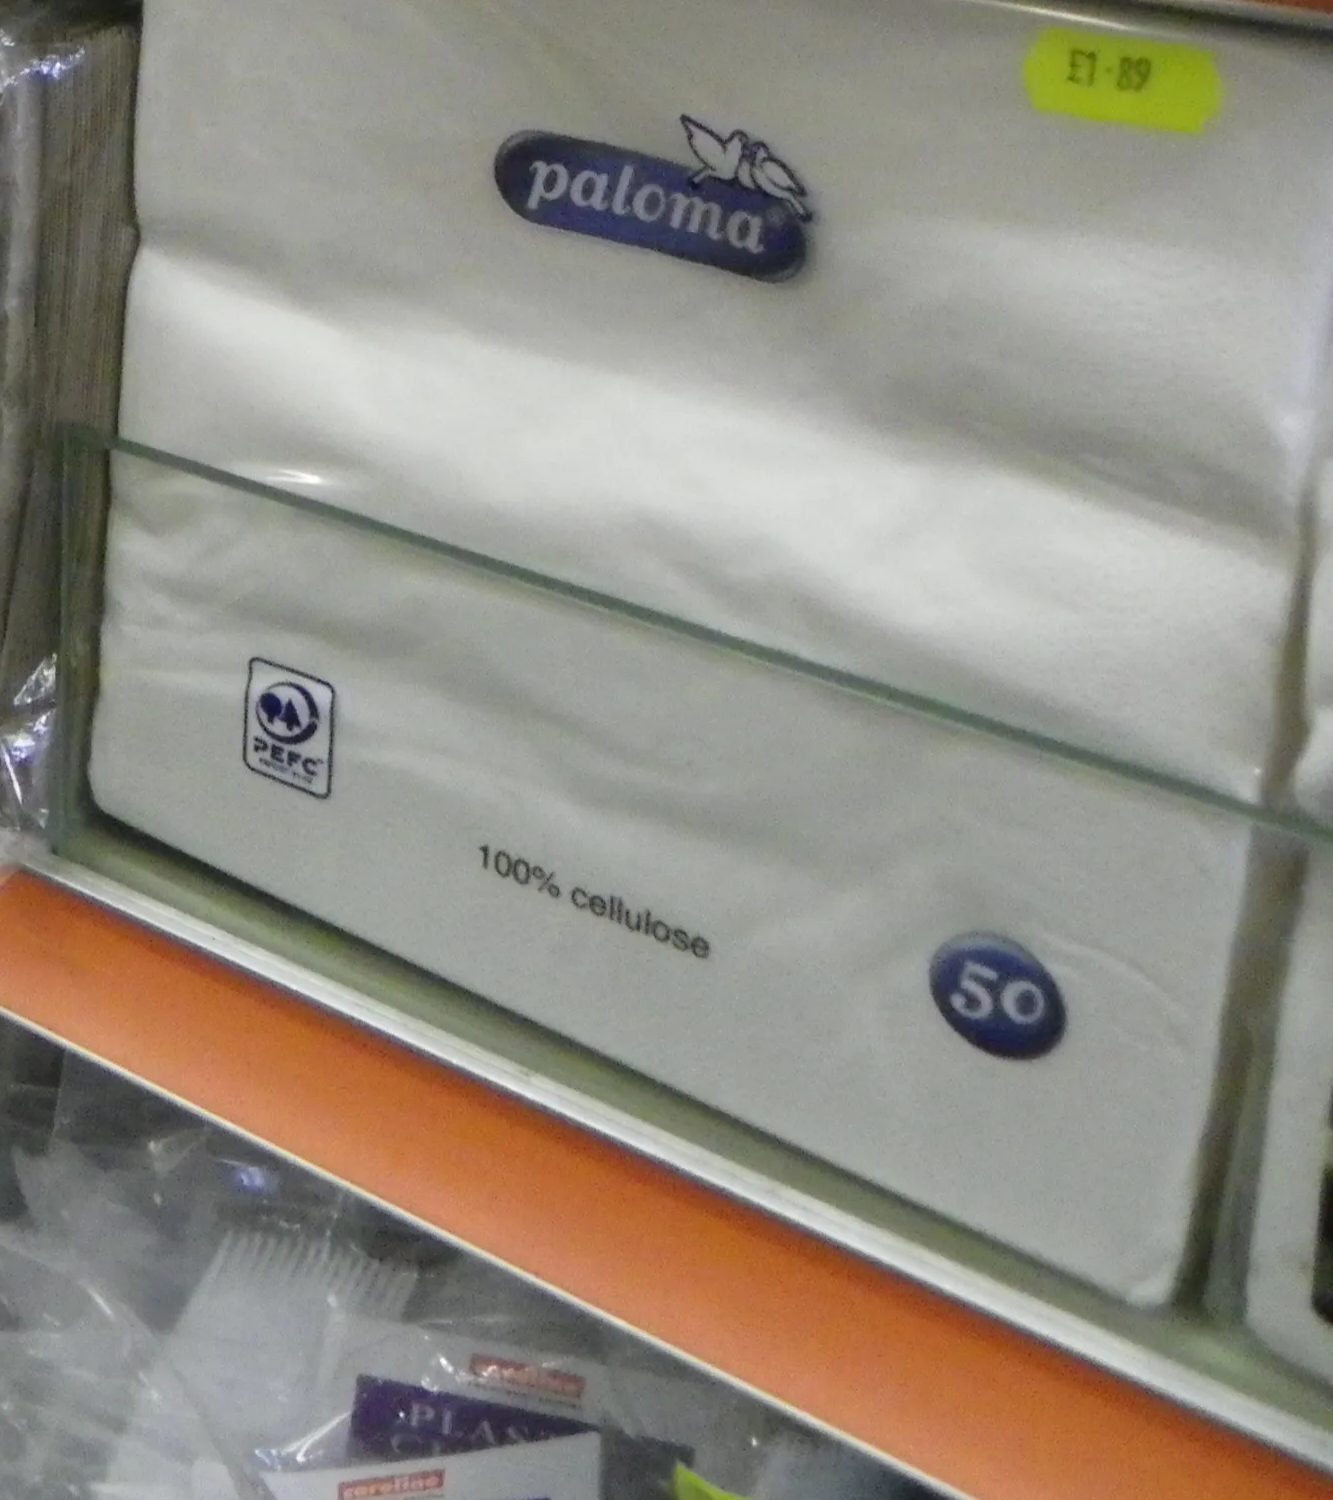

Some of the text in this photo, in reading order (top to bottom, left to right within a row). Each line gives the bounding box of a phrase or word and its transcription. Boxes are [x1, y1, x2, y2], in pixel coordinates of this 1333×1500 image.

[529, 159, 765, 254] paloma
[252, 736, 319, 777] PEFC
[478, 844, 711, 958] 100% cellulose
[949, 960, 1045, 1025] 50
